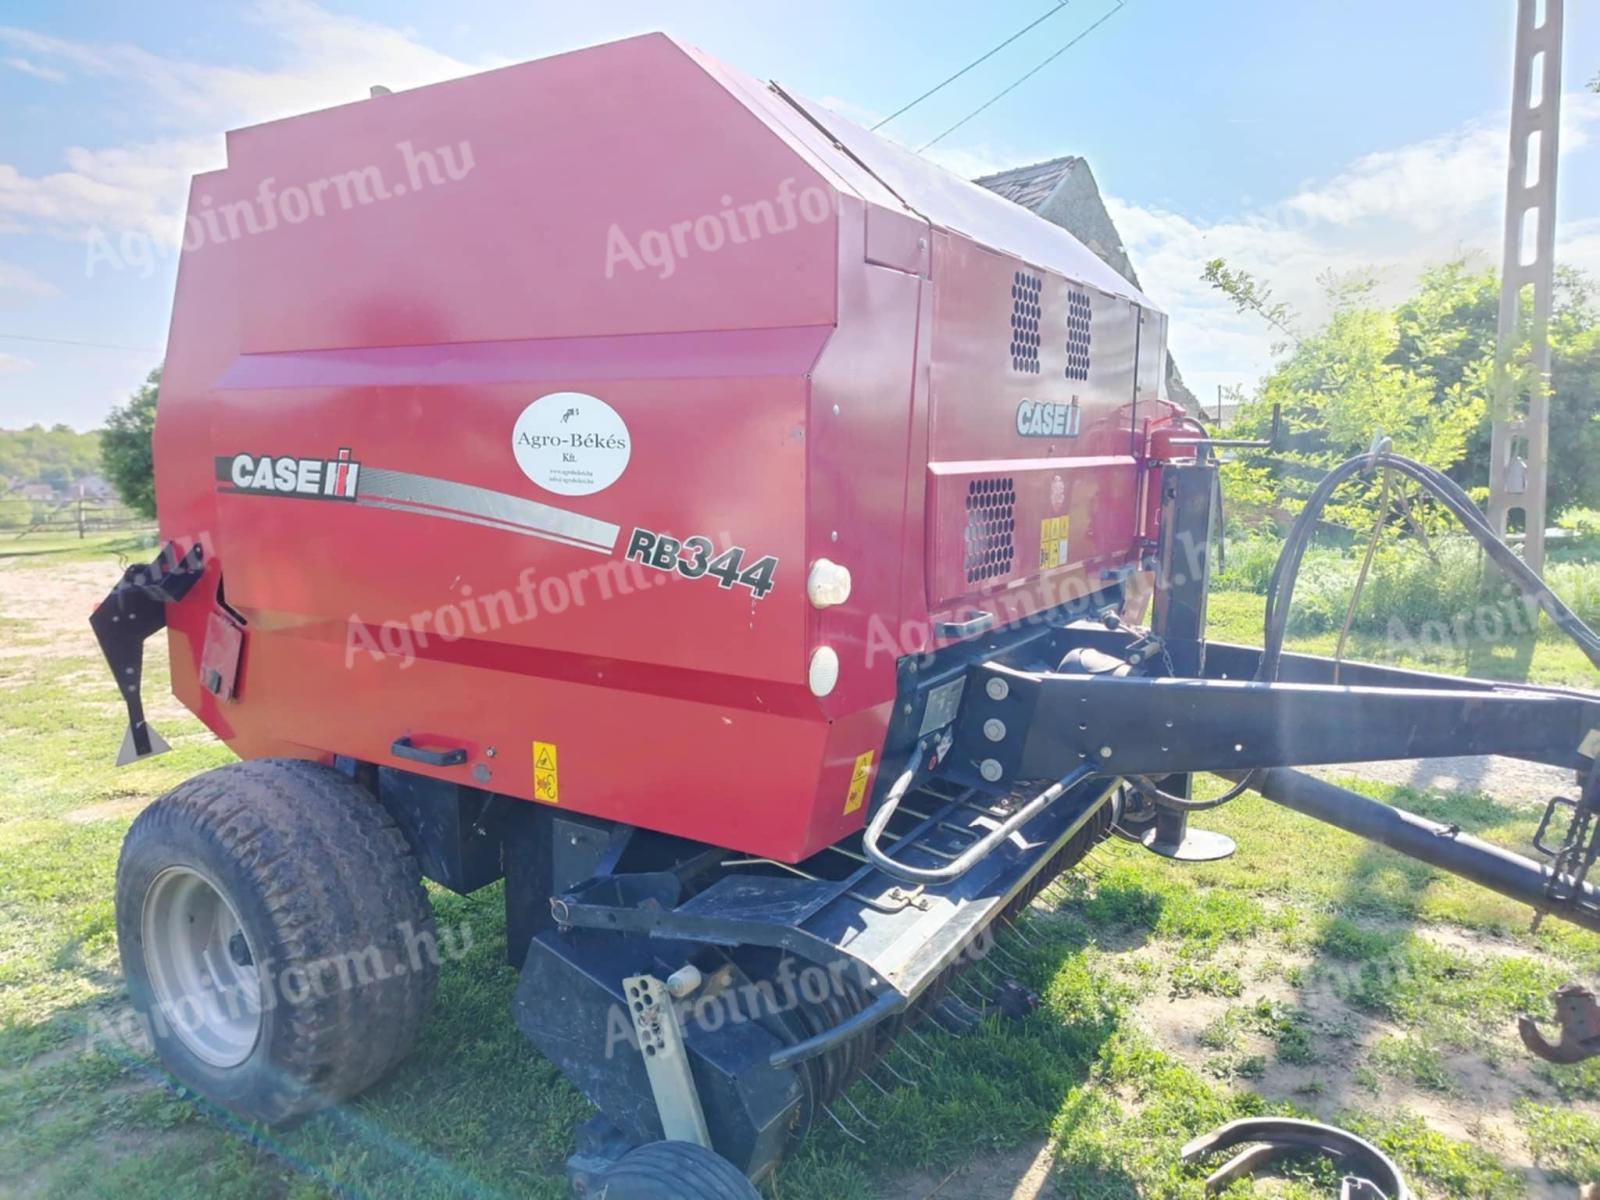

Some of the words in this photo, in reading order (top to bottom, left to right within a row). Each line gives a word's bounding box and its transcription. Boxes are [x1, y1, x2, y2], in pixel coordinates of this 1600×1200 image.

[517, 431, 627, 450] Agro-Békés
[230, 452, 322, 494] CASE
[625, 527, 779, 600] RB344
